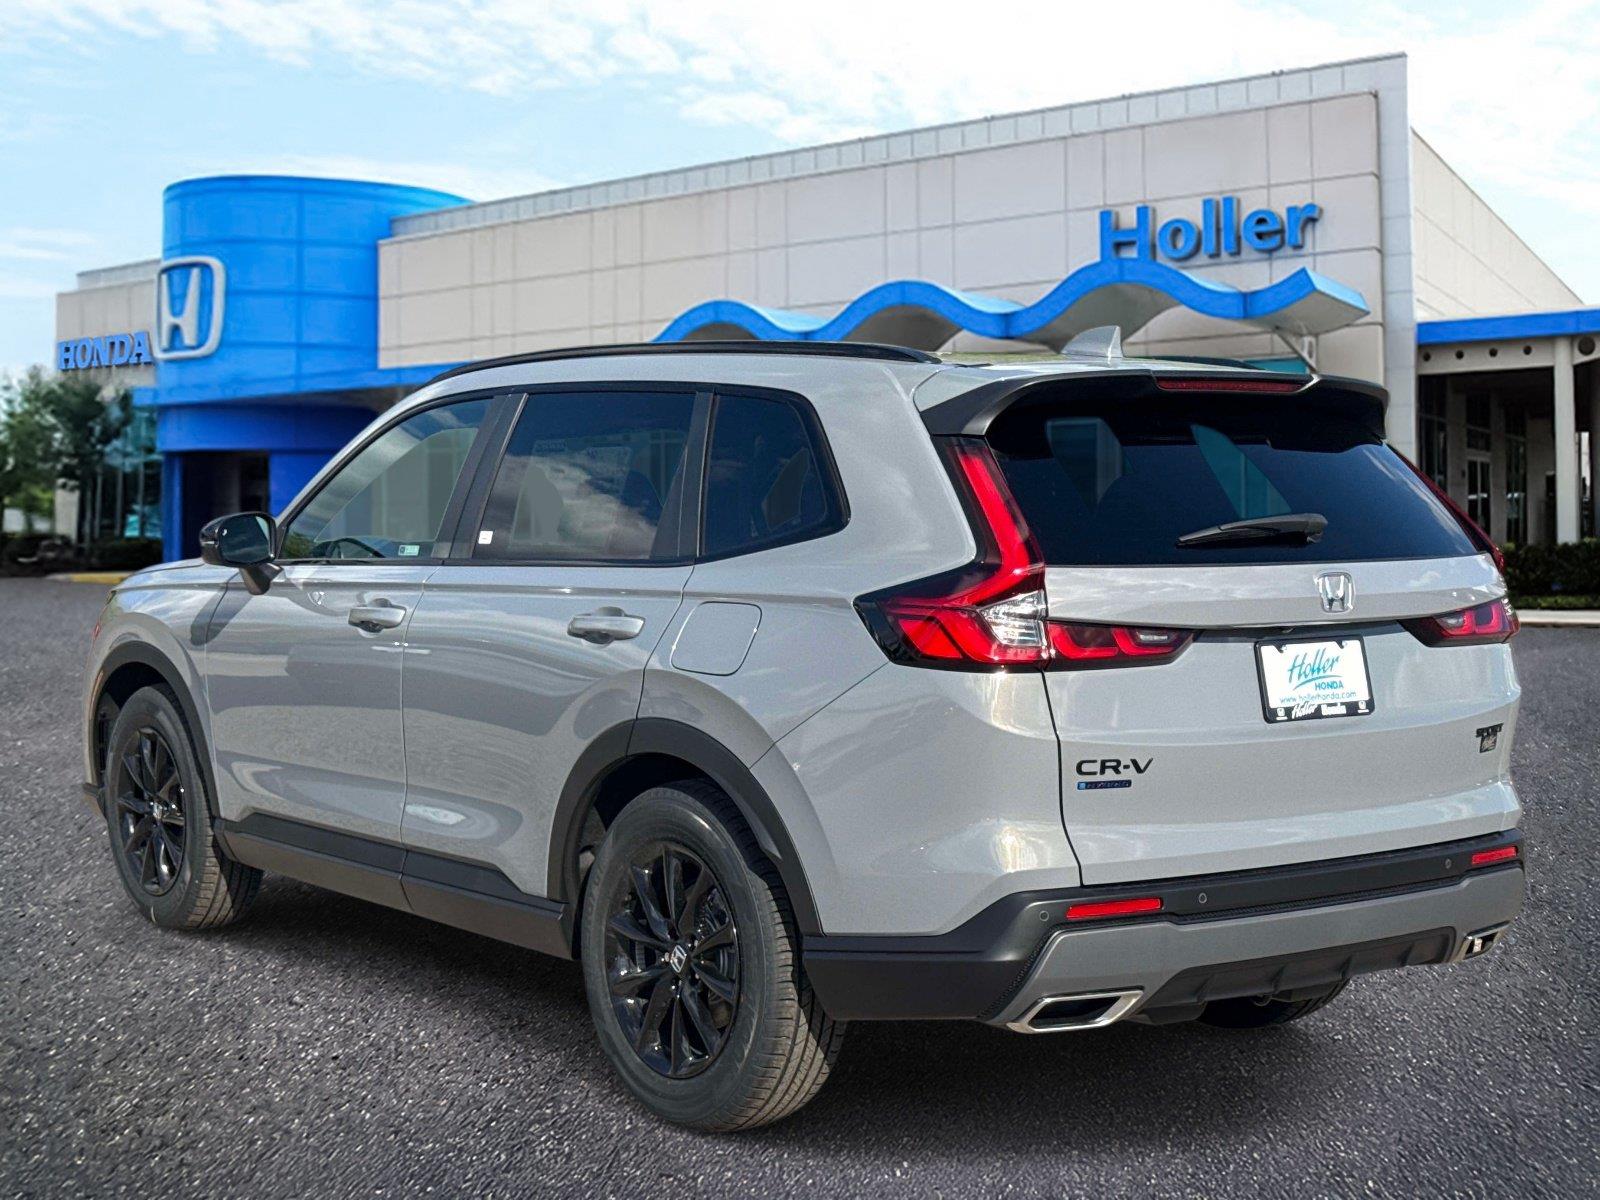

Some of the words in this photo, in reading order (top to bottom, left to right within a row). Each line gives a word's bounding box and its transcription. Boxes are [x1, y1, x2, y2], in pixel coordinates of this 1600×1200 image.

[1099, 196, 1322, 262] Holler
[58, 331, 153, 371] HONDA
[1287, 647, 1341, 684] Holler
[1279, 690, 1357, 703] www.hollerhonda.com
[1314, 680, 1344, 691] HONDA
[1076, 757, 1153, 776] CR-V
